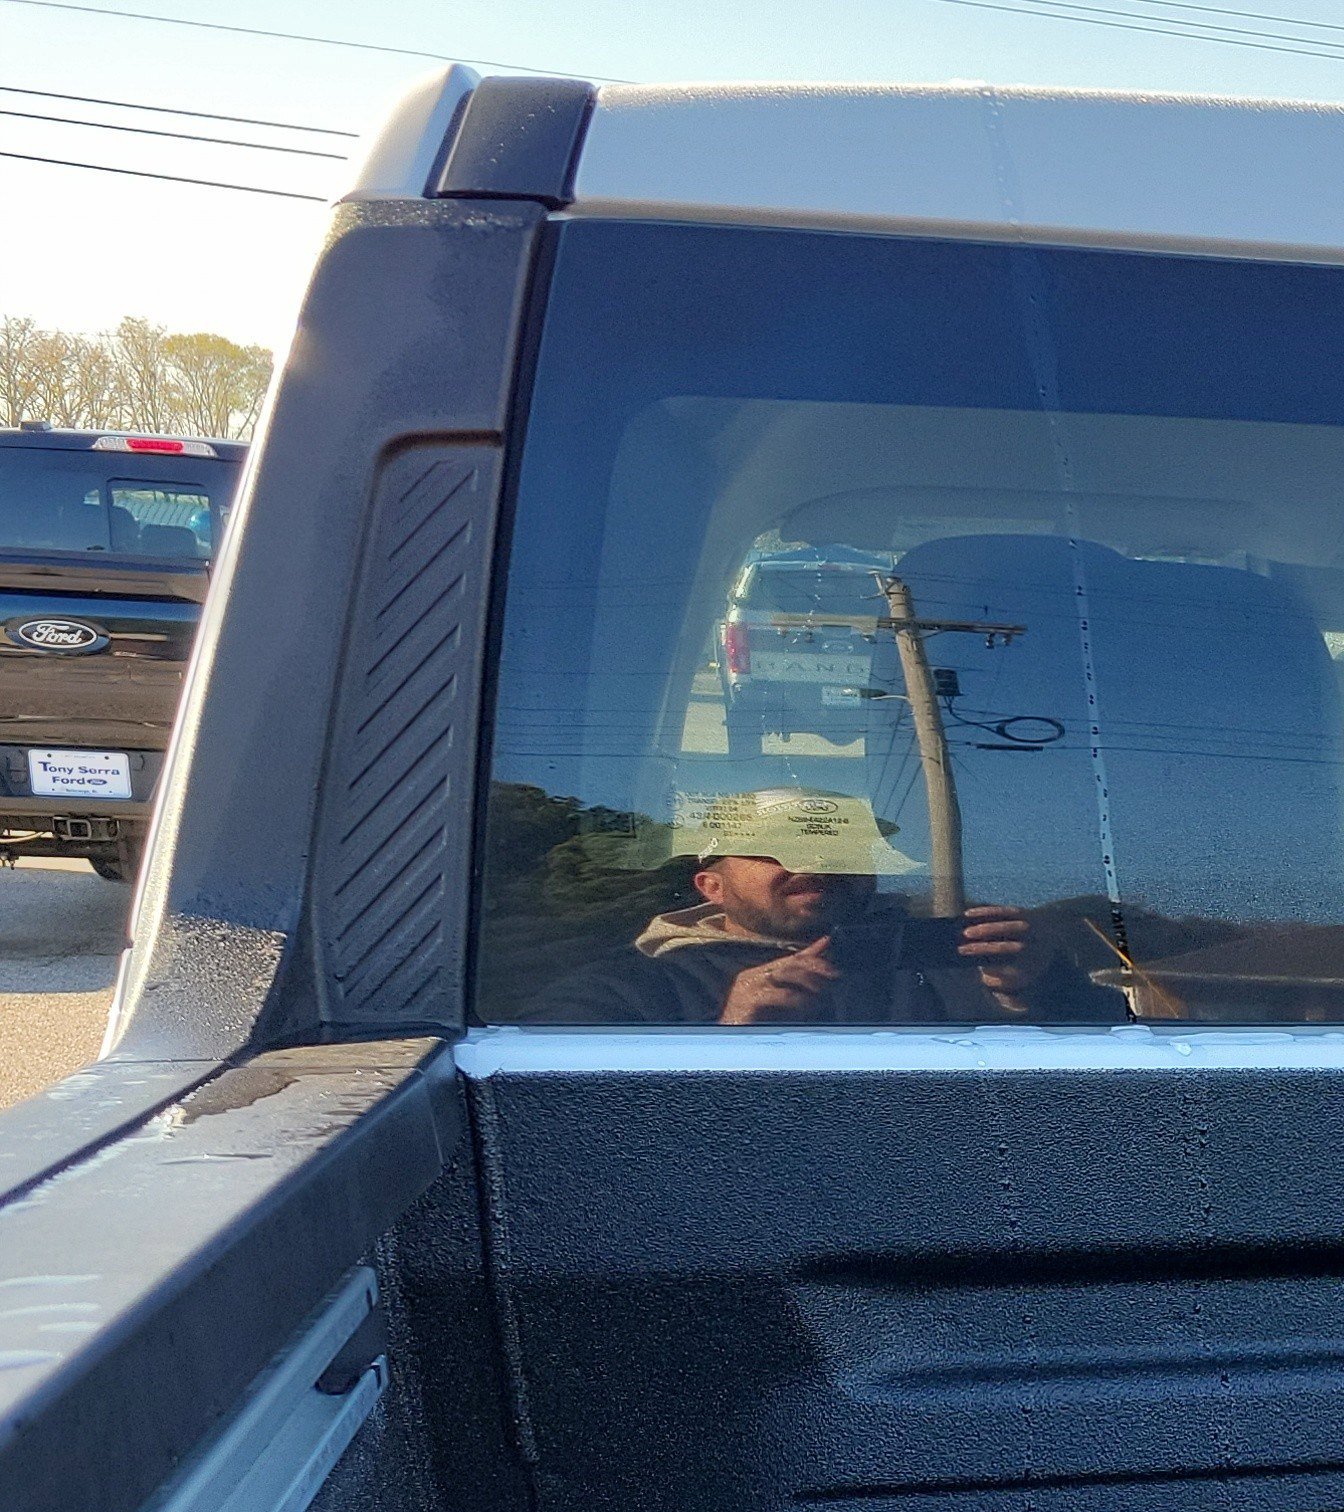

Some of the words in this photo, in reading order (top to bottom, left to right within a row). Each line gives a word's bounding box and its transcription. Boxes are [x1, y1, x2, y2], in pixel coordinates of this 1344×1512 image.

[32, 624, 82, 643] Ford
[38, 761, 74, 775] Tony
[52, 776, 86, 785] Ford
